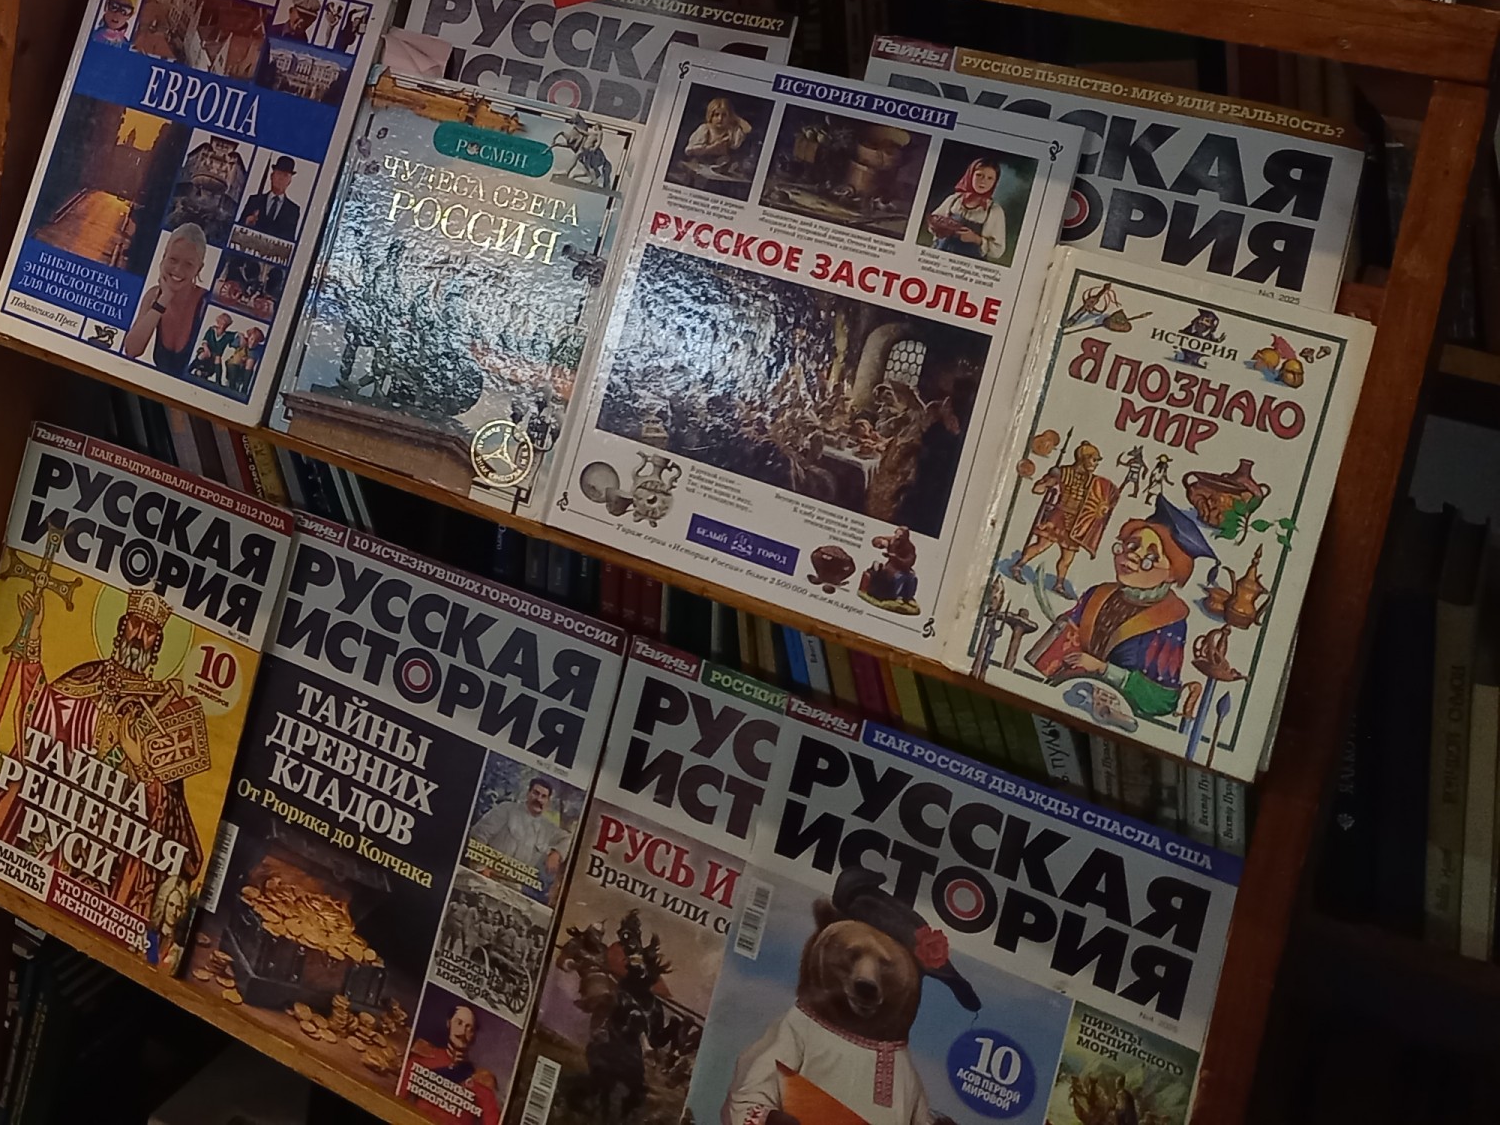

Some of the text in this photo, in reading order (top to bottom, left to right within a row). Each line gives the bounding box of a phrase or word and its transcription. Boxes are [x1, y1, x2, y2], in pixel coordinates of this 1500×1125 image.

[700, 6, 785, 32] РУССКИХ?
[874, 37, 949, 64] Тайны
[139, 64, 262, 138] ЕВРОПА
[777, 78, 952, 127] ИСТОРИЯ РОССИИ
[960, 55, 1346, 138] РУССКОЕ ПЬЯНСТВО: МИФ ИЛИ РЕАЛЬНОСТЬ?
[383, 154, 580, 228] ЧУДЕСА СВЕТА
[386, 189, 563, 267] РОССИЯ
[23, 261, 130, 307] ЭНЦИКЛОПЕДИЙ
[38, 250, 120, 291] БИБЛИОТЕКА
[650, 211, 1003, 326] РУССКОЕ ЗАСТОЛЬЕ
[18, 275, 124, 321] ДЛЯ ЮНОШЕСТВА
[1150, 326, 1239, 362] ИСТОРИЯ
[1067, 336, 1306, 440] Я ПОЗНАЮ
[35, 426, 83, 453] Тайны
[1115, 399, 1219, 455] МИР
[90, 445, 286, 531] КАК ВЫДУМЫВАЛИ ГЕРОЕВ 1812 ГОДА
[31, 452, 277, 588] РУССКАЯ
[694, 525, 789, 567] БЕЛЫЙ ГОРОД
[20, 500, 263, 636] ИСТОРИЯ
[353, 535, 619, 649] 10 ИСЧЕЗНУВШИХ ГОРОДОВ РОССИИ
[290, 545, 602, 713] РУССКАЯ
[198, 645, 237, 690] 10
[276, 597, 586, 770] ИСТОРИЯ
[634, 640, 697, 676] Тайны
[296, 681, 434, 770] ТАЙНЫ
[785, 697, 858, 737] Тайны
[24, 727, 149, 821] ТАЙНА
[265, 711, 439, 816] ДРЕВНИХ
[268, 751, 416, 846] КЛАДОВ
[872, 730, 1213, 872] КАК РОССИЯ ДВАЖДЫ СПАСЛА США
[17, 807, 119, 885] РУСИ
[237, 777, 434, 889] От Рюрика до Колчака
[469, 837, 539, 877] ВНЕБРАЧНЫЕ
[790, 735, 1211, 952] РУССКАЯ
[465, 848, 545, 893] ДЕТИ СТАЛИНА
[593, 815, 741, 910] РУСЬ И
[57, 876, 146, 935] ЧТО ПОГУБИЛО
[585, 856, 711, 932] Враги или
[774, 798, 1195, 1021] ИСТОРИЯ
[52, 891, 151, 955] МЕНШИКОВА?
[435, 967, 491, 1001] МИРОВОЙ
[438, 958, 486, 989] ПЕРВОЙ
[1075, 1034, 1121, 1064] МОРЯ
[1078, 1023, 1184, 1076] КАСПИЙСКОГО
[1080, 1013, 1145, 1048] ПИРАТЫ
[412, 1061, 476, 1103] ЛЮБОВНЫЕ
[956, 1065, 1023, 1105] АСОВ ПЕРВОЙ
[967, 1033, 1023, 1089] 10
[406, 1081, 457, 1118] НИКОЛАЯ
[408, 1072, 483, 1117] ПОХОЖДЕНИЯ
[962, 1080, 1018, 1114] МИРОВОЙ
